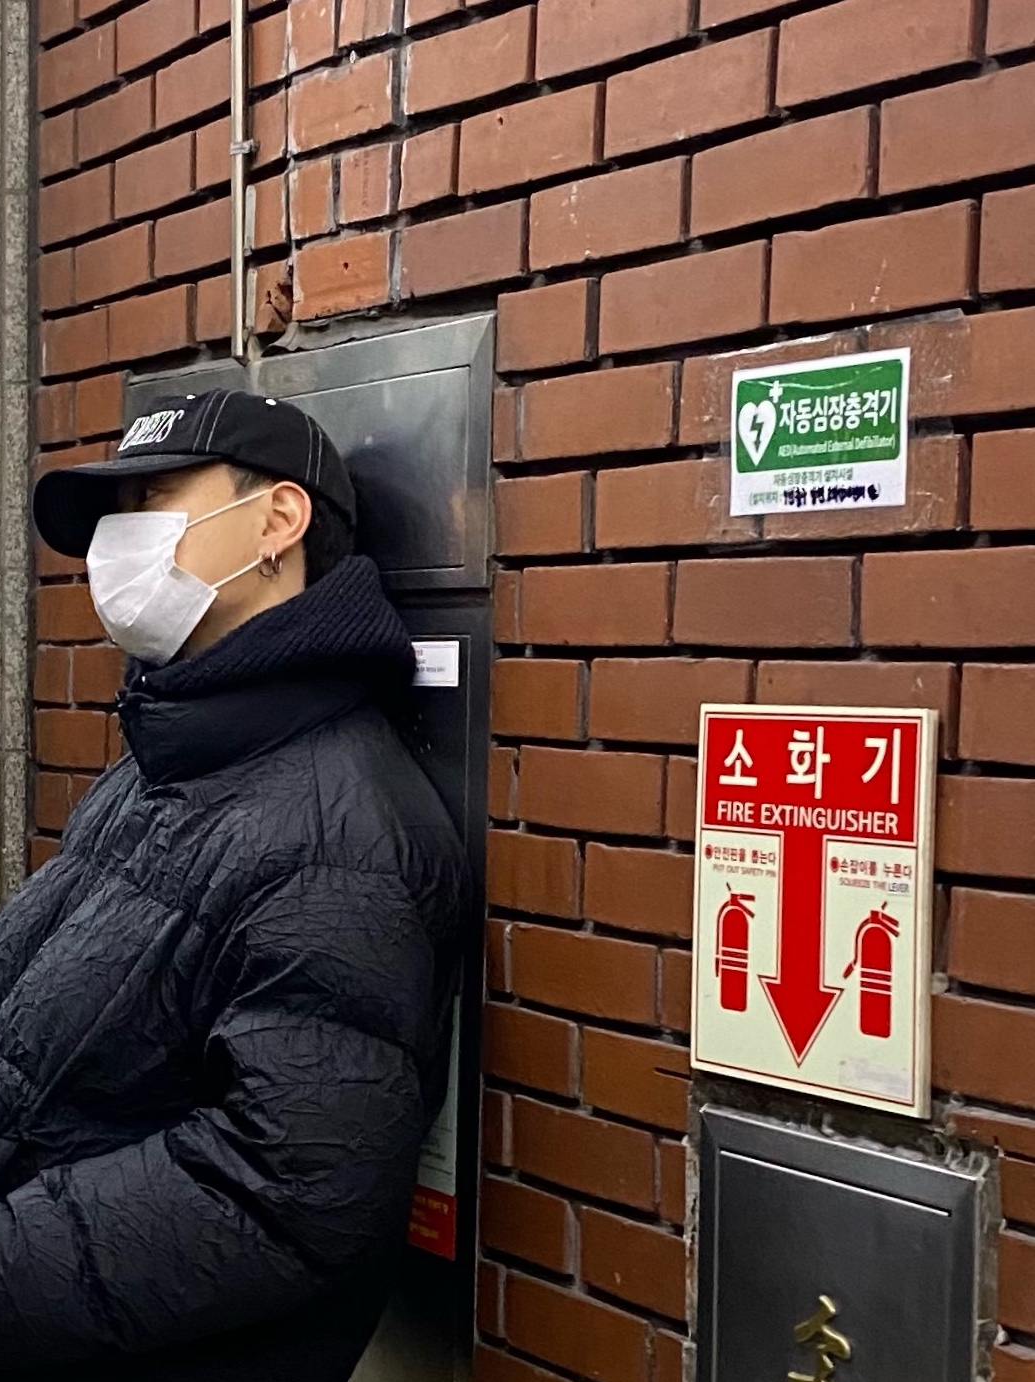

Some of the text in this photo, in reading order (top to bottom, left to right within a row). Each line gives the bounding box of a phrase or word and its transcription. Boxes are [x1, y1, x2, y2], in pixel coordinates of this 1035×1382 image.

[779, 387, 898, 434] 자동심장충격기
[717, 800, 899, 836] FIRE EXTINGUISHER
